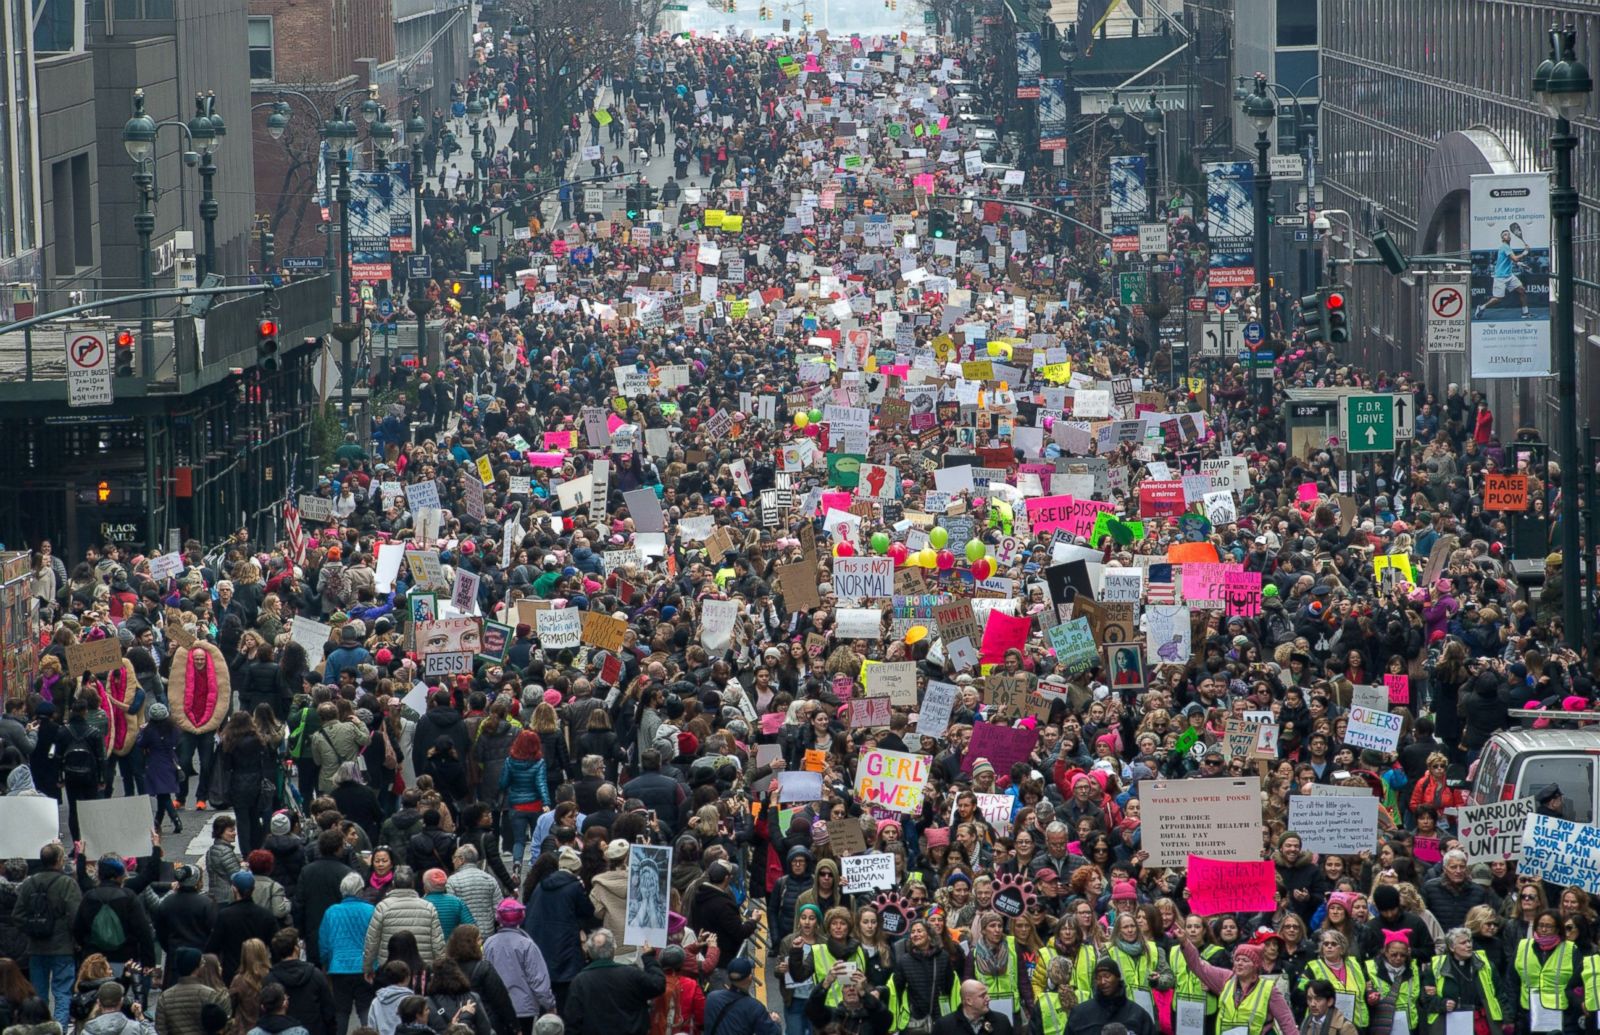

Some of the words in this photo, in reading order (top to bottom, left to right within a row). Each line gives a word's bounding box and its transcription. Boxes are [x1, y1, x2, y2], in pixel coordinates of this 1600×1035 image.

[1498, 328, 1538, 336] Anniversary
[1113, 379, 1132, 394] NO!
[1358, 402, 1383, 411] F.D.R.
[706, 412, 727, 428] EQUAL
[1357, 414, 1385, 424] DRIVE
[711, 419, 732, 438] RIGHTS
[1203, 460, 1230, 469] RUMP
[1211, 476, 1230, 487] BAD
[1490, 480, 1524, 490] RAISE
[1489, 493, 1524, 504] PLOW
[1058, 506, 1073, 521] UP
[101, 522, 137, 534] BLACK
[104, 532, 135, 542] SAILS
[1056, 530, 1073, 542] YES
[835, 560, 857, 574] This
[861, 560, 869, 573] is
[871, 560, 892, 574] NOT
[835, 574, 892, 597] NORMAL
[1105, 576, 1140, 587] THANKS
[1107, 589, 1124, 599] BUT
[1128, 589, 1140, 599] NO
[895, 607, 914, 618] THE
[938, 604, 972, 625] POWER
[941, 623, 977, 641] CONSENT
[1050, 628, 1064, 638] We
[1066, 621, 1081, 631] will
[540, 630, 579, 646] FORMATION
[1054, 636, 1069, 648] not
[1071, 632, 1083, 644] go
[1057, 643, 1081, 659] gentle
[1081, 639, 1096, 650] into
[428, 655, 472, 672] RESIST
[870, 664, 886, 674] KATE
[1069, 658, 1093, 674] night
[989, 678, 1023, 692] SAVE
[992, 691, 1017, 706] ROE
[1025, 694, 1053, 709] UALITY
[1351, 708, 1400, 731] QUEERS
[1227, 722, 1237, 732] I
[1244, 724, 1258, 733] AM
[1229, 734, 1254, 745] WITH
[1230, 744, 1249, 756] YOU
[867, 753, 924, 782] GIRL
[1151, 796, 1188, 804] WOMAN'S
[1192, 795, 1221, 803] POWER
[1226, 794, 1251, 802] POSSE
[985, 806, 1010, 823] HTS
[1465, 800, 1534, 824] WARRIORS
[1159, 822, 1212, 830] AFFORDABLE
[1217, 821, 1250, 829] HEALTH
[1328, 819, 1350, 827] powerful
[1474, 821, 1493, 836] OF
[1536, 815, 1546, 824] IF
[1556, 819, 1575, 832] YOU
[1580, 824, 1600, 837] ARE
[1326, 827, 1341, 835] every
[1534, 825, 1573, 842] SILENT
[1576, 833, 1600, 849] ABOU
[1206, 848, 1237, 856] CARING
[1469, 834, 1521, 857] UNITE
[1532, 836, 1561, 851] YOUR
[1565, 844, 1591, 858] PAIN
[1523, 845, 1567, 864] THEY'LL
[1570, 855, 1596, 871] KILL
[846, 864, 875, 875] RIGHTS
[1524, 856, 1545, 869] YOU
[1551, 863, 1574, 876] AND
[1576, 869, 1600, 884] SAY
[847, 872, 885, 884] HUMAN
[1518, 863, 1539, 876] YOU
[1542, 870, 1586, 889] ENJOYED
[1588, 881, 1600, 894] IT
[847, 881, 871, 891] RIGHTS
[1006, 904, 1019, 914] KITTY
